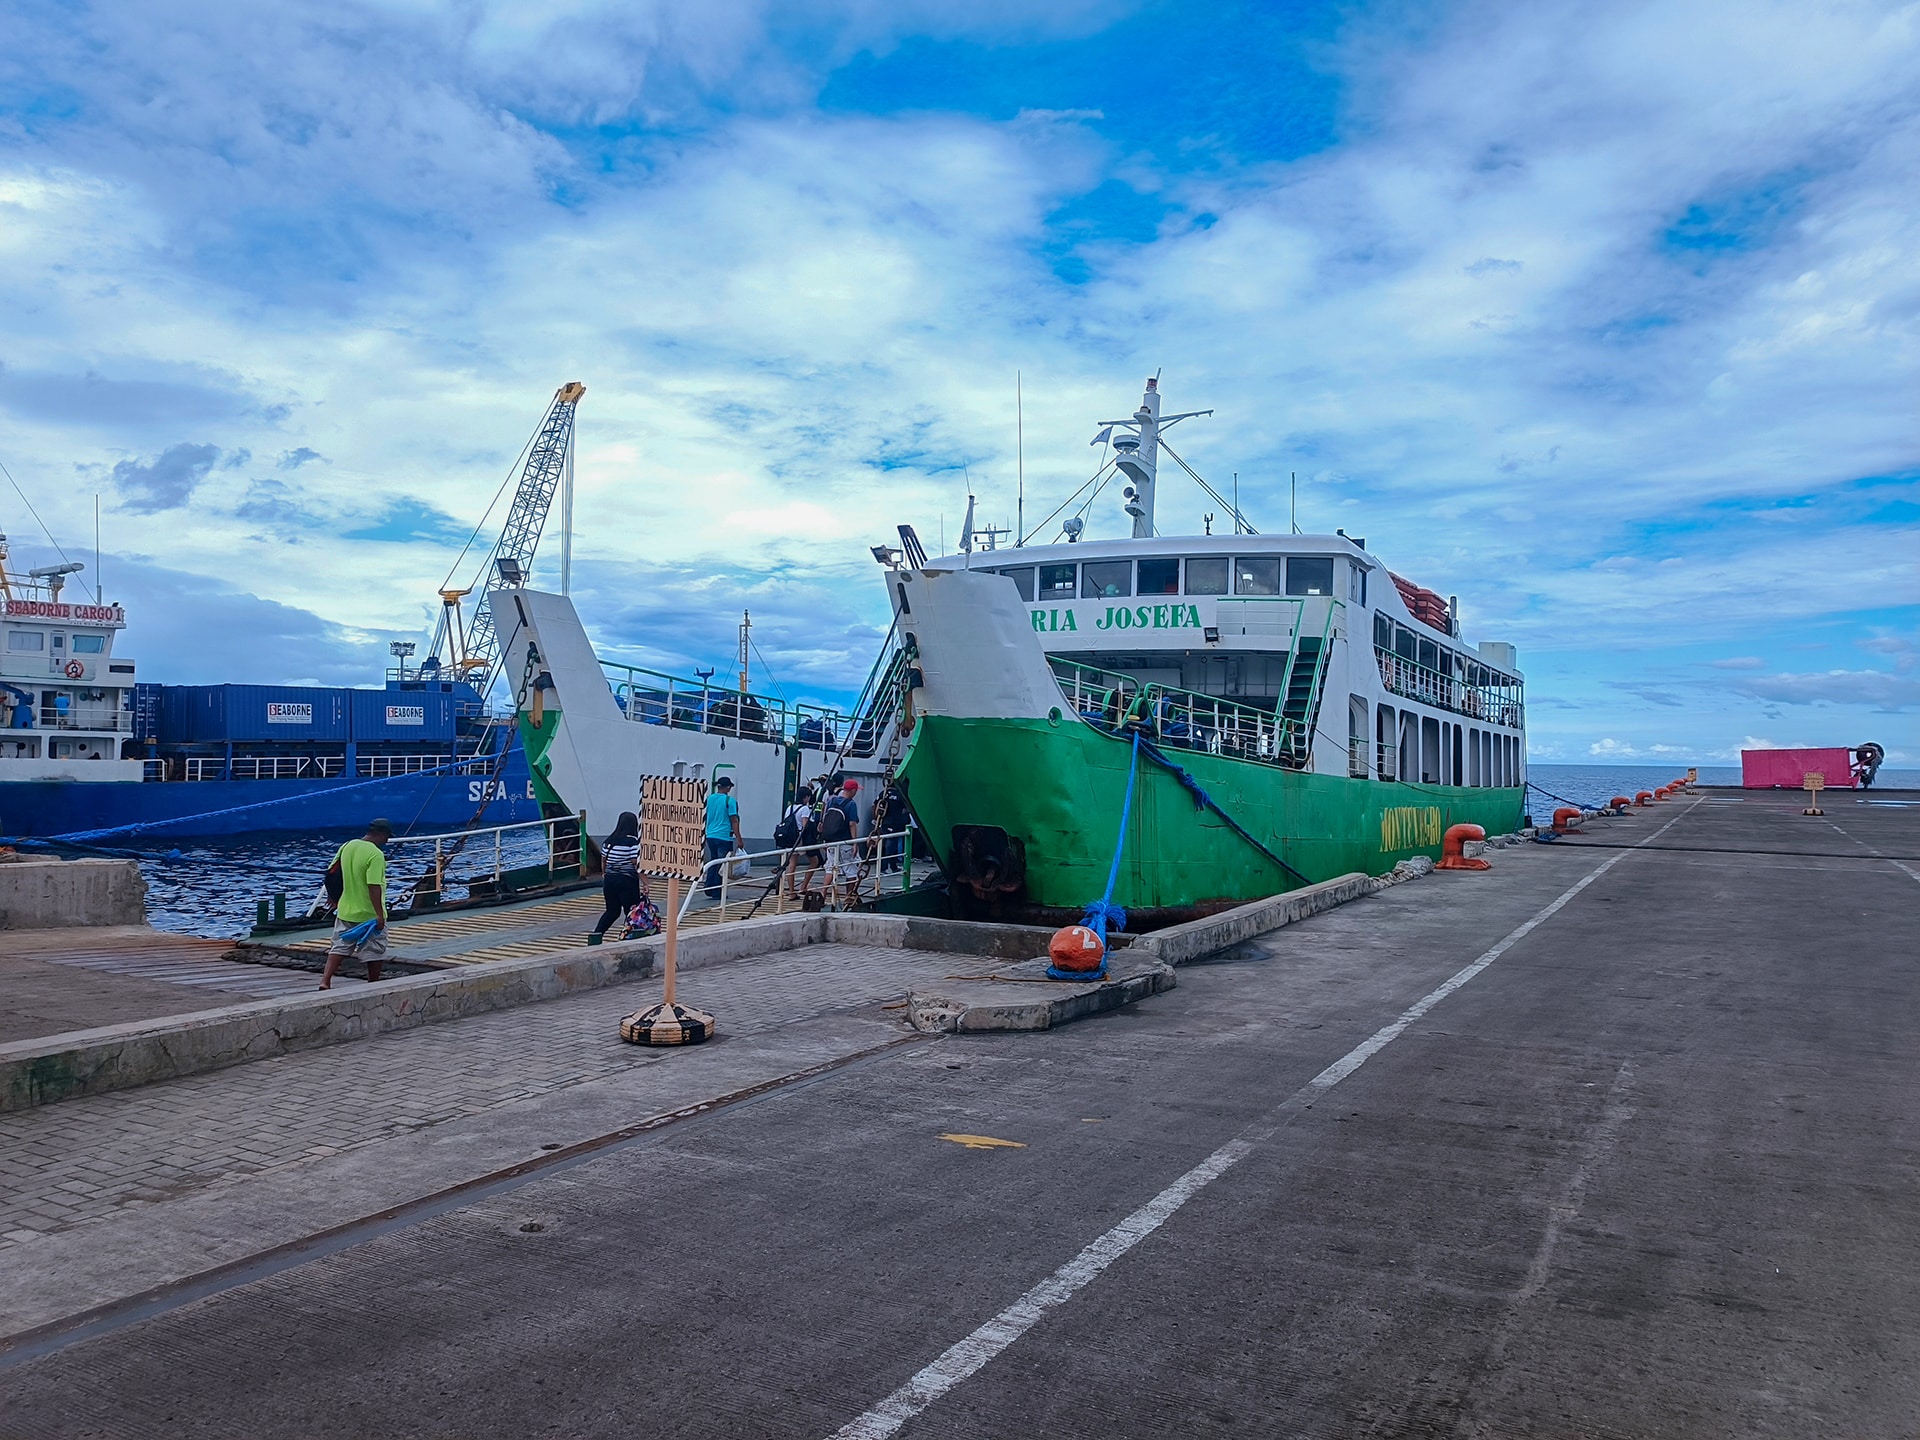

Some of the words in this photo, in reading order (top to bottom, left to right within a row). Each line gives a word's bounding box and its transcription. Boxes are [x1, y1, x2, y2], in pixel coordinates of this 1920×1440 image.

[7, 601, 70, 617] SEABORNE
[75, 606, 113, 620] CARGO
[1096, 602, 1201, 629] JOSEFA
[269, 704, 311, 716] SEABORNE
[469, 781, 507, 802] SEA
[642, 778, 705, 803] CAUTION
[662, 825, 683, 844] TIMES
[660, 845, 677, 864] CHIN
[1072, 927, 1096, 950] 2
